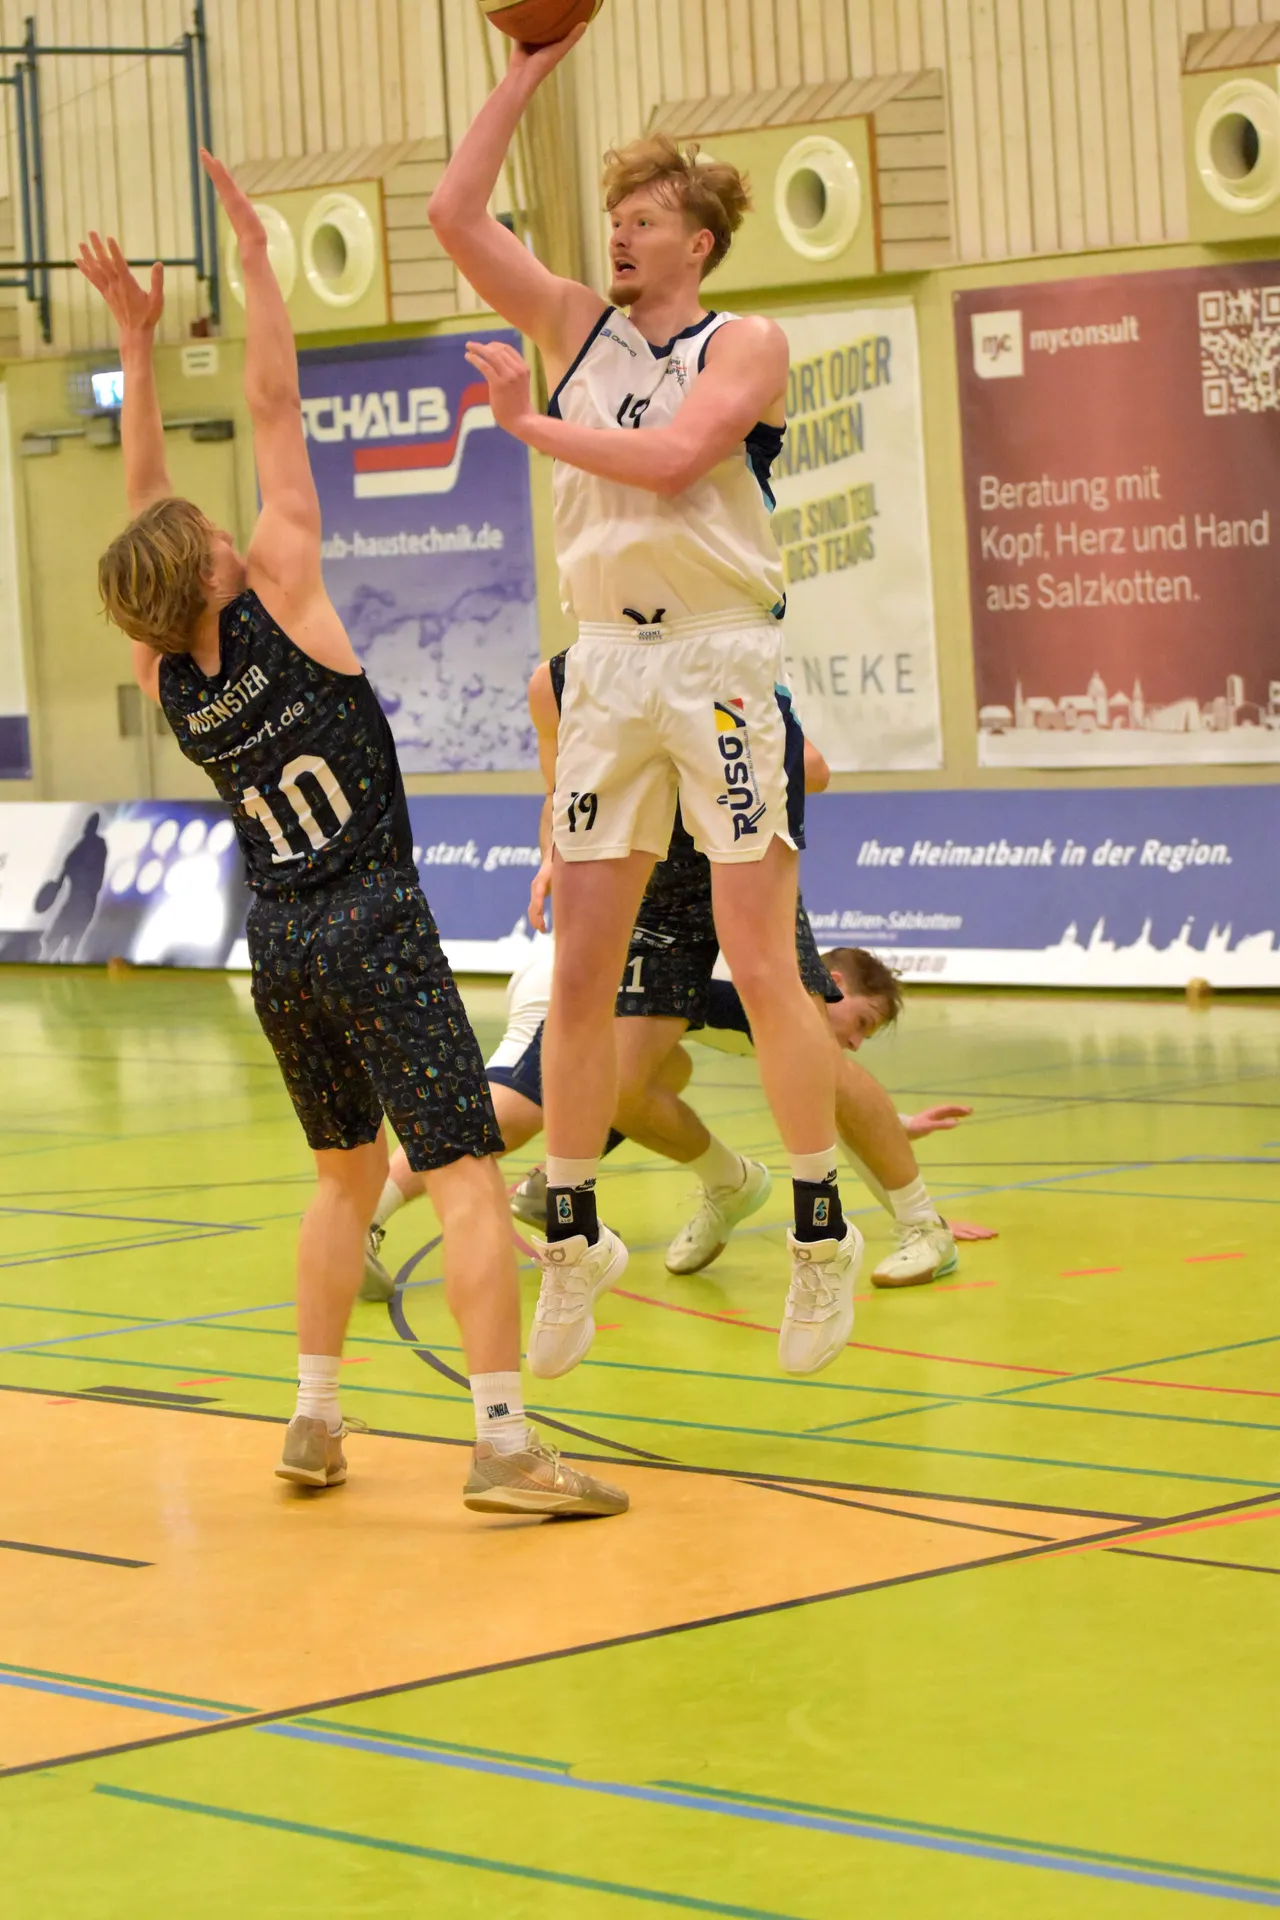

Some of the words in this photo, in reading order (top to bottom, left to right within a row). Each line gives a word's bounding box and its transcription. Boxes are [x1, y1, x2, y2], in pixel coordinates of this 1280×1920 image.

[1030, 316, 1140, 354] myconsult
[830, 335, 891, 401] ODER
[617, 393, 650, 428] 19
[979, 473, 1109, 512] Beratung
[1116, 465, 1162, 500] mit
[981, 522, 1050, 566] Kopf,
[1055, 521, 1127, 556] Herz
[1133, 515, 1187, 552] und
[1195, 509, 1270, 548] Hand
[986, 582, 1029, 611] aus
[1036, 570, 1201, 608] Salzkotten.
[183, 664, 269, 735] MUENSTER
[241, 754, 353, 864] 10
[568, 791, 599, 833] 19
[424, 839, 481, 869] stark,
[857, 839, 904, 866] Ihre
[909, 838, 1057, 867] Heimatbank
[1060, 839, 1086, 866] in
[1092, 839, 1136, 867] der
[1140, 838, 1233, 873] Region.
[618, 955, 646, 993] 1
[494, 1402, 510, 1418] NBA
